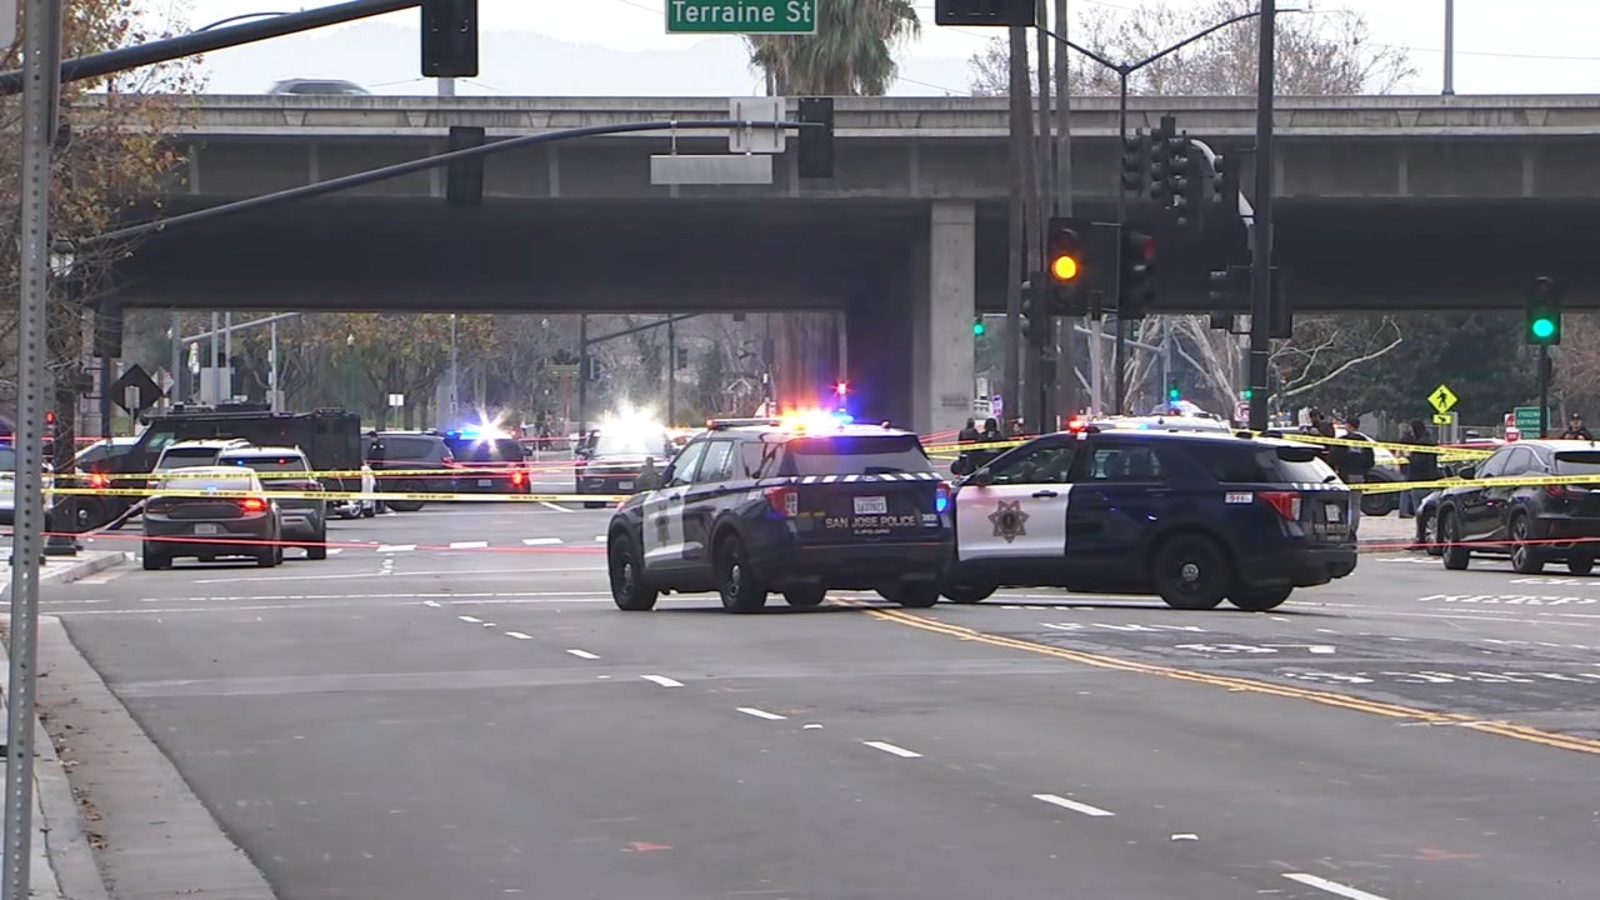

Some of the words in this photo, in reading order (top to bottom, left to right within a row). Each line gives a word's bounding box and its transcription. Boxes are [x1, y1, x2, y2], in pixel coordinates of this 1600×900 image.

[672, 1, 775, 23] Terraine
[786, 1, 811, 23] St
[825, 517, 849, 529] SAN
[852, 516, 878, 528] JOSE
[880, 515, 916, 527] POLICE
